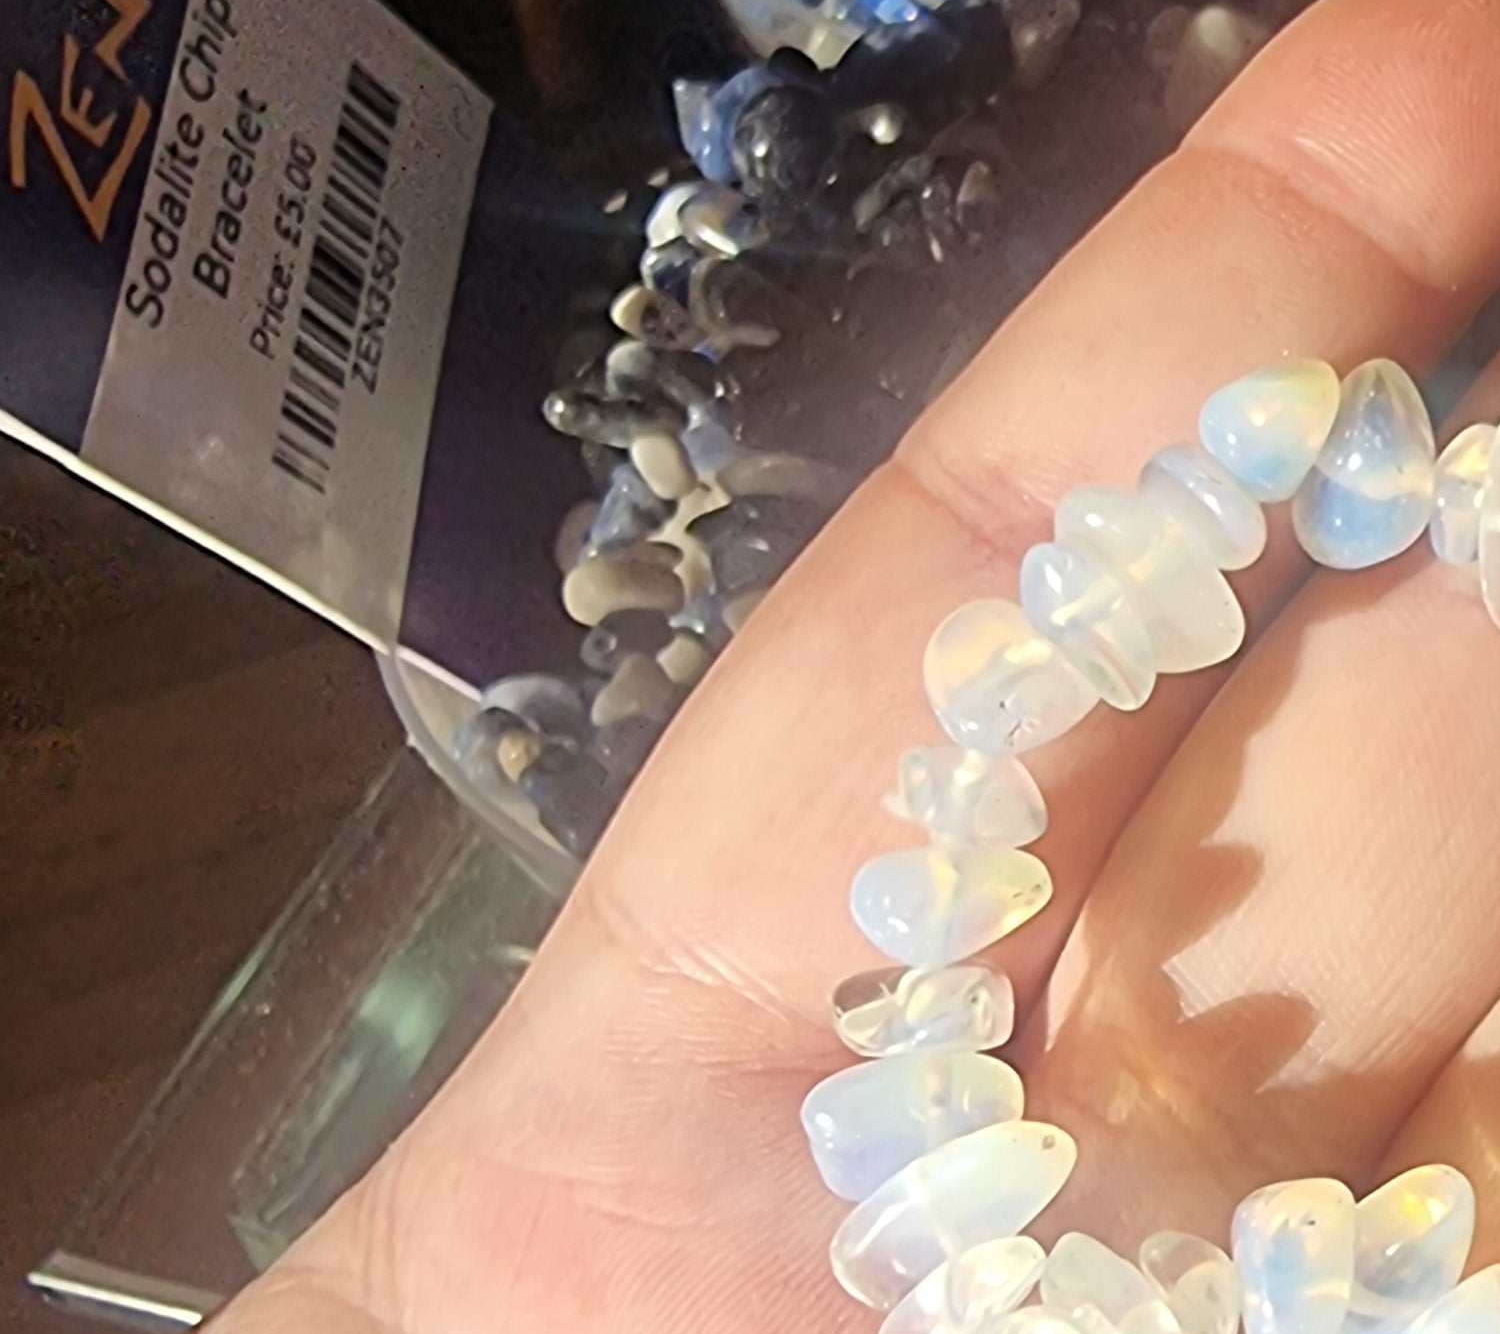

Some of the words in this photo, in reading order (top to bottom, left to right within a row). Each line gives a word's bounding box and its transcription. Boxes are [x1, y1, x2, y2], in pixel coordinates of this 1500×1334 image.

[124, 110, 206, 329] Sodalite
[191, 87, 268, 300] Bracelet
[248, 245, 297, 360] Price:
[273, 135, 318, 251] £5.00
